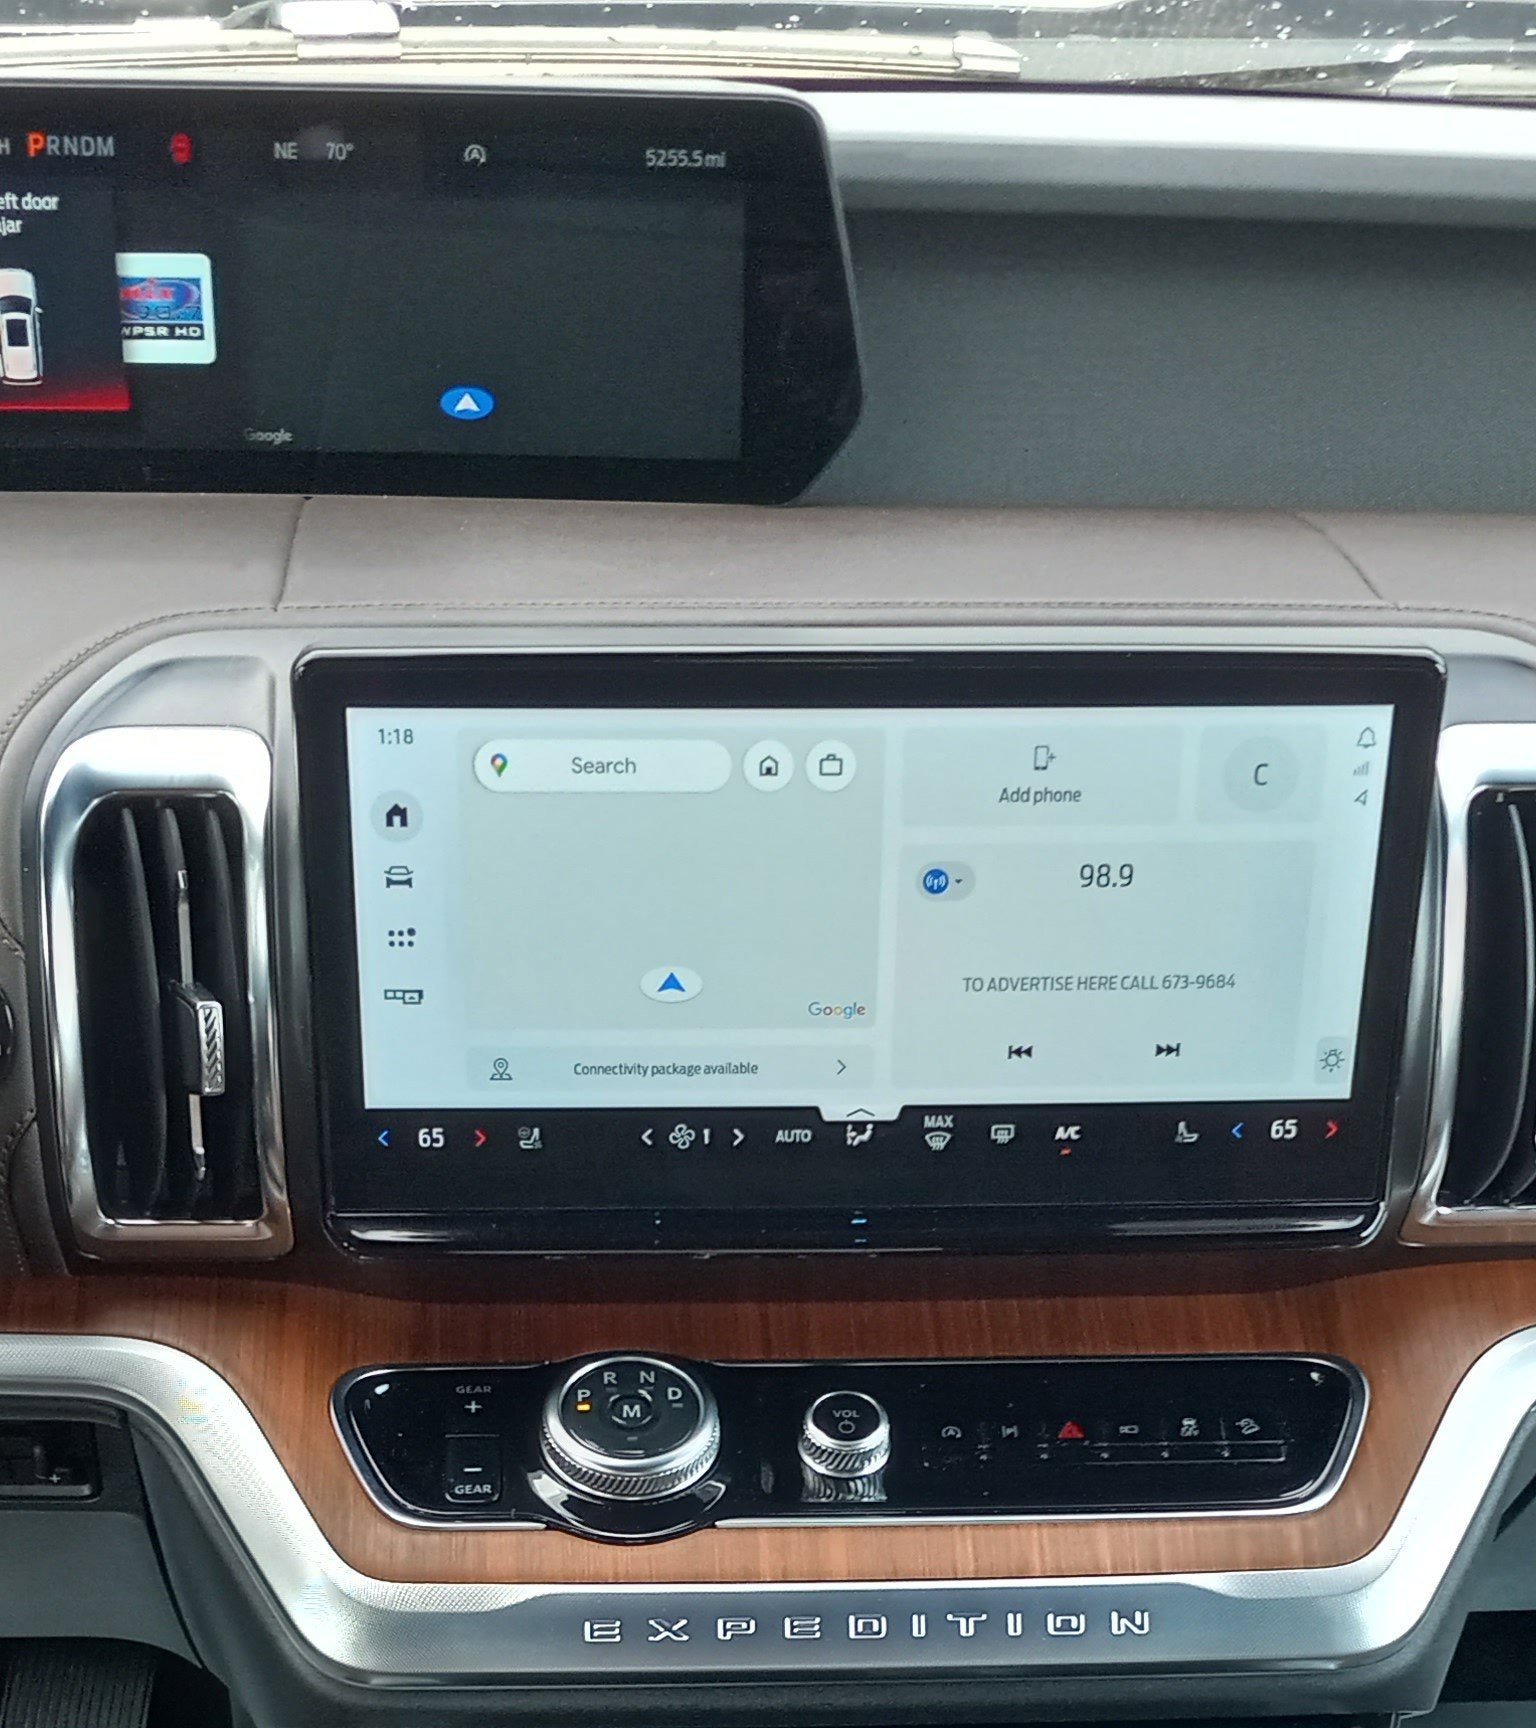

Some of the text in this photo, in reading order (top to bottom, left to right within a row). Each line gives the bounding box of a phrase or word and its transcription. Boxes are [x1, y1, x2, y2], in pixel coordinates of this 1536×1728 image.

[274, 142, 297, 160] NE
[22, 192, 59, 210] door
[245, 427, 294, 444] Google
[378, 728, 414, 745] 1:18
[571, 757, 637, 775] Search
[1254, 763, 1269, 786] C
[999, 787, 1081, 806] Add phone
[1080, 863, 1134, 888] 98.9
[963, 974, 1236, 992] TO ADVERTISE HERE CALL 673-9684
[808, 1001, 866, 1019] Google
[574, 1062, 758, 1077] Connectivity package available
[924, 1115, 954, 1128] MAX
[1270, 1119, 1298, 1140] 65
[418, 1127, 445, 1148] 65
[775, 1129, 812, 1144] AUTO
[1054, 1126, 1081, 1141] A/C
[603, 1371, 617, 1384] R
[639, 1370, 655, 1383] N
[455, 1384, 492, 1394] GEAR
[577, 1389, 592, 1401] P
[668, 1387, 683, 1400] D
[622, 1404, 641, 1418] M
[832, 1409, 860, 1418] VOL
[454, 1484, 492, 1495] GEAR
[584, 1608, 1151, 1644] EXPEDITION
